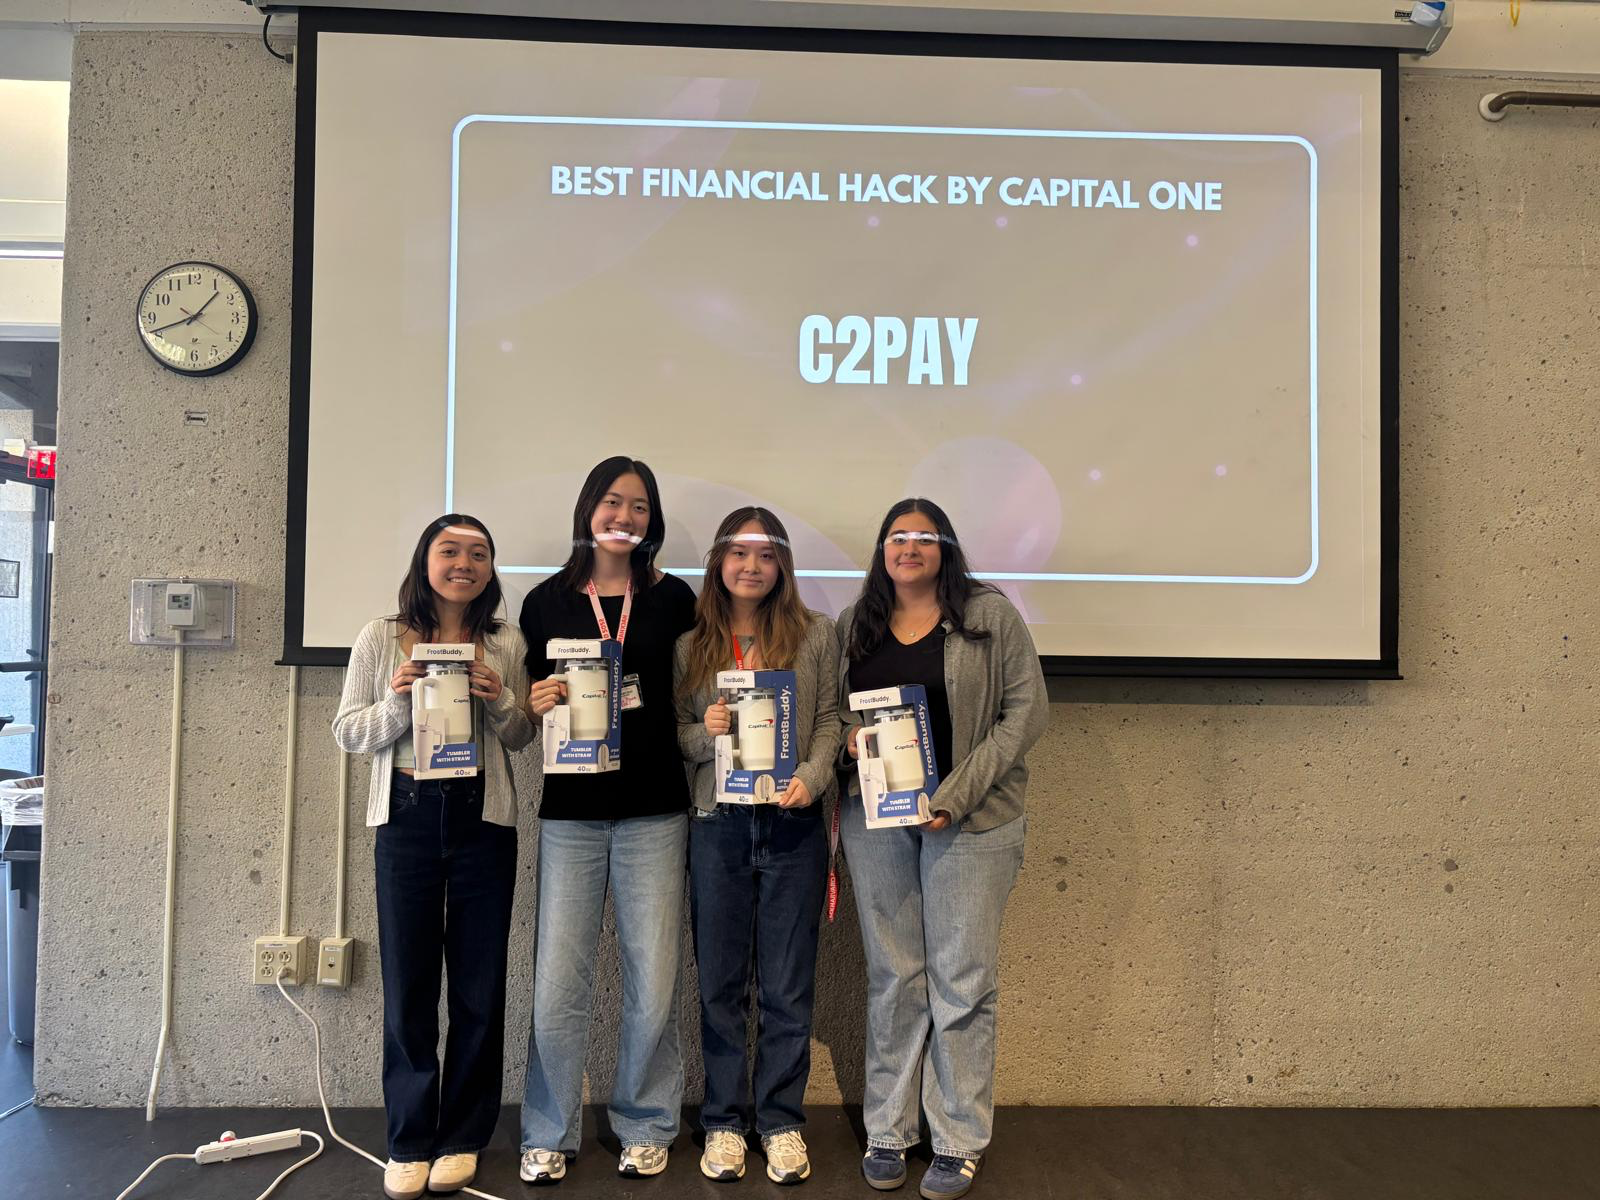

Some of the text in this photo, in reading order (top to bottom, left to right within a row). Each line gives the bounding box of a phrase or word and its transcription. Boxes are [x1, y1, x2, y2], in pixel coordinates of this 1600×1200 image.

[551, 166, 1222, 211] BEST FINANCIAL HACK BY CAPITAL ONE
[169, 279, 181, 291] 11
[188, 273, 202, 285] 12
[213, 278, 218, 291] 1
[156, 294, 170, 306] 10
[226, 293, 235, 306] 2
[148, 311, 156, 325] 9
[231, 311, 240, 325] 3
[226, 330, 233, 342] 4
[190, 350, 199, 362] 6
[209, 344, 219, 357] 5
[799, 314, 979, 386] C2PAY
[780, 684, 792, 759] FrostBuddy.
[917, 700, 935, 776] FrostBuddy.
